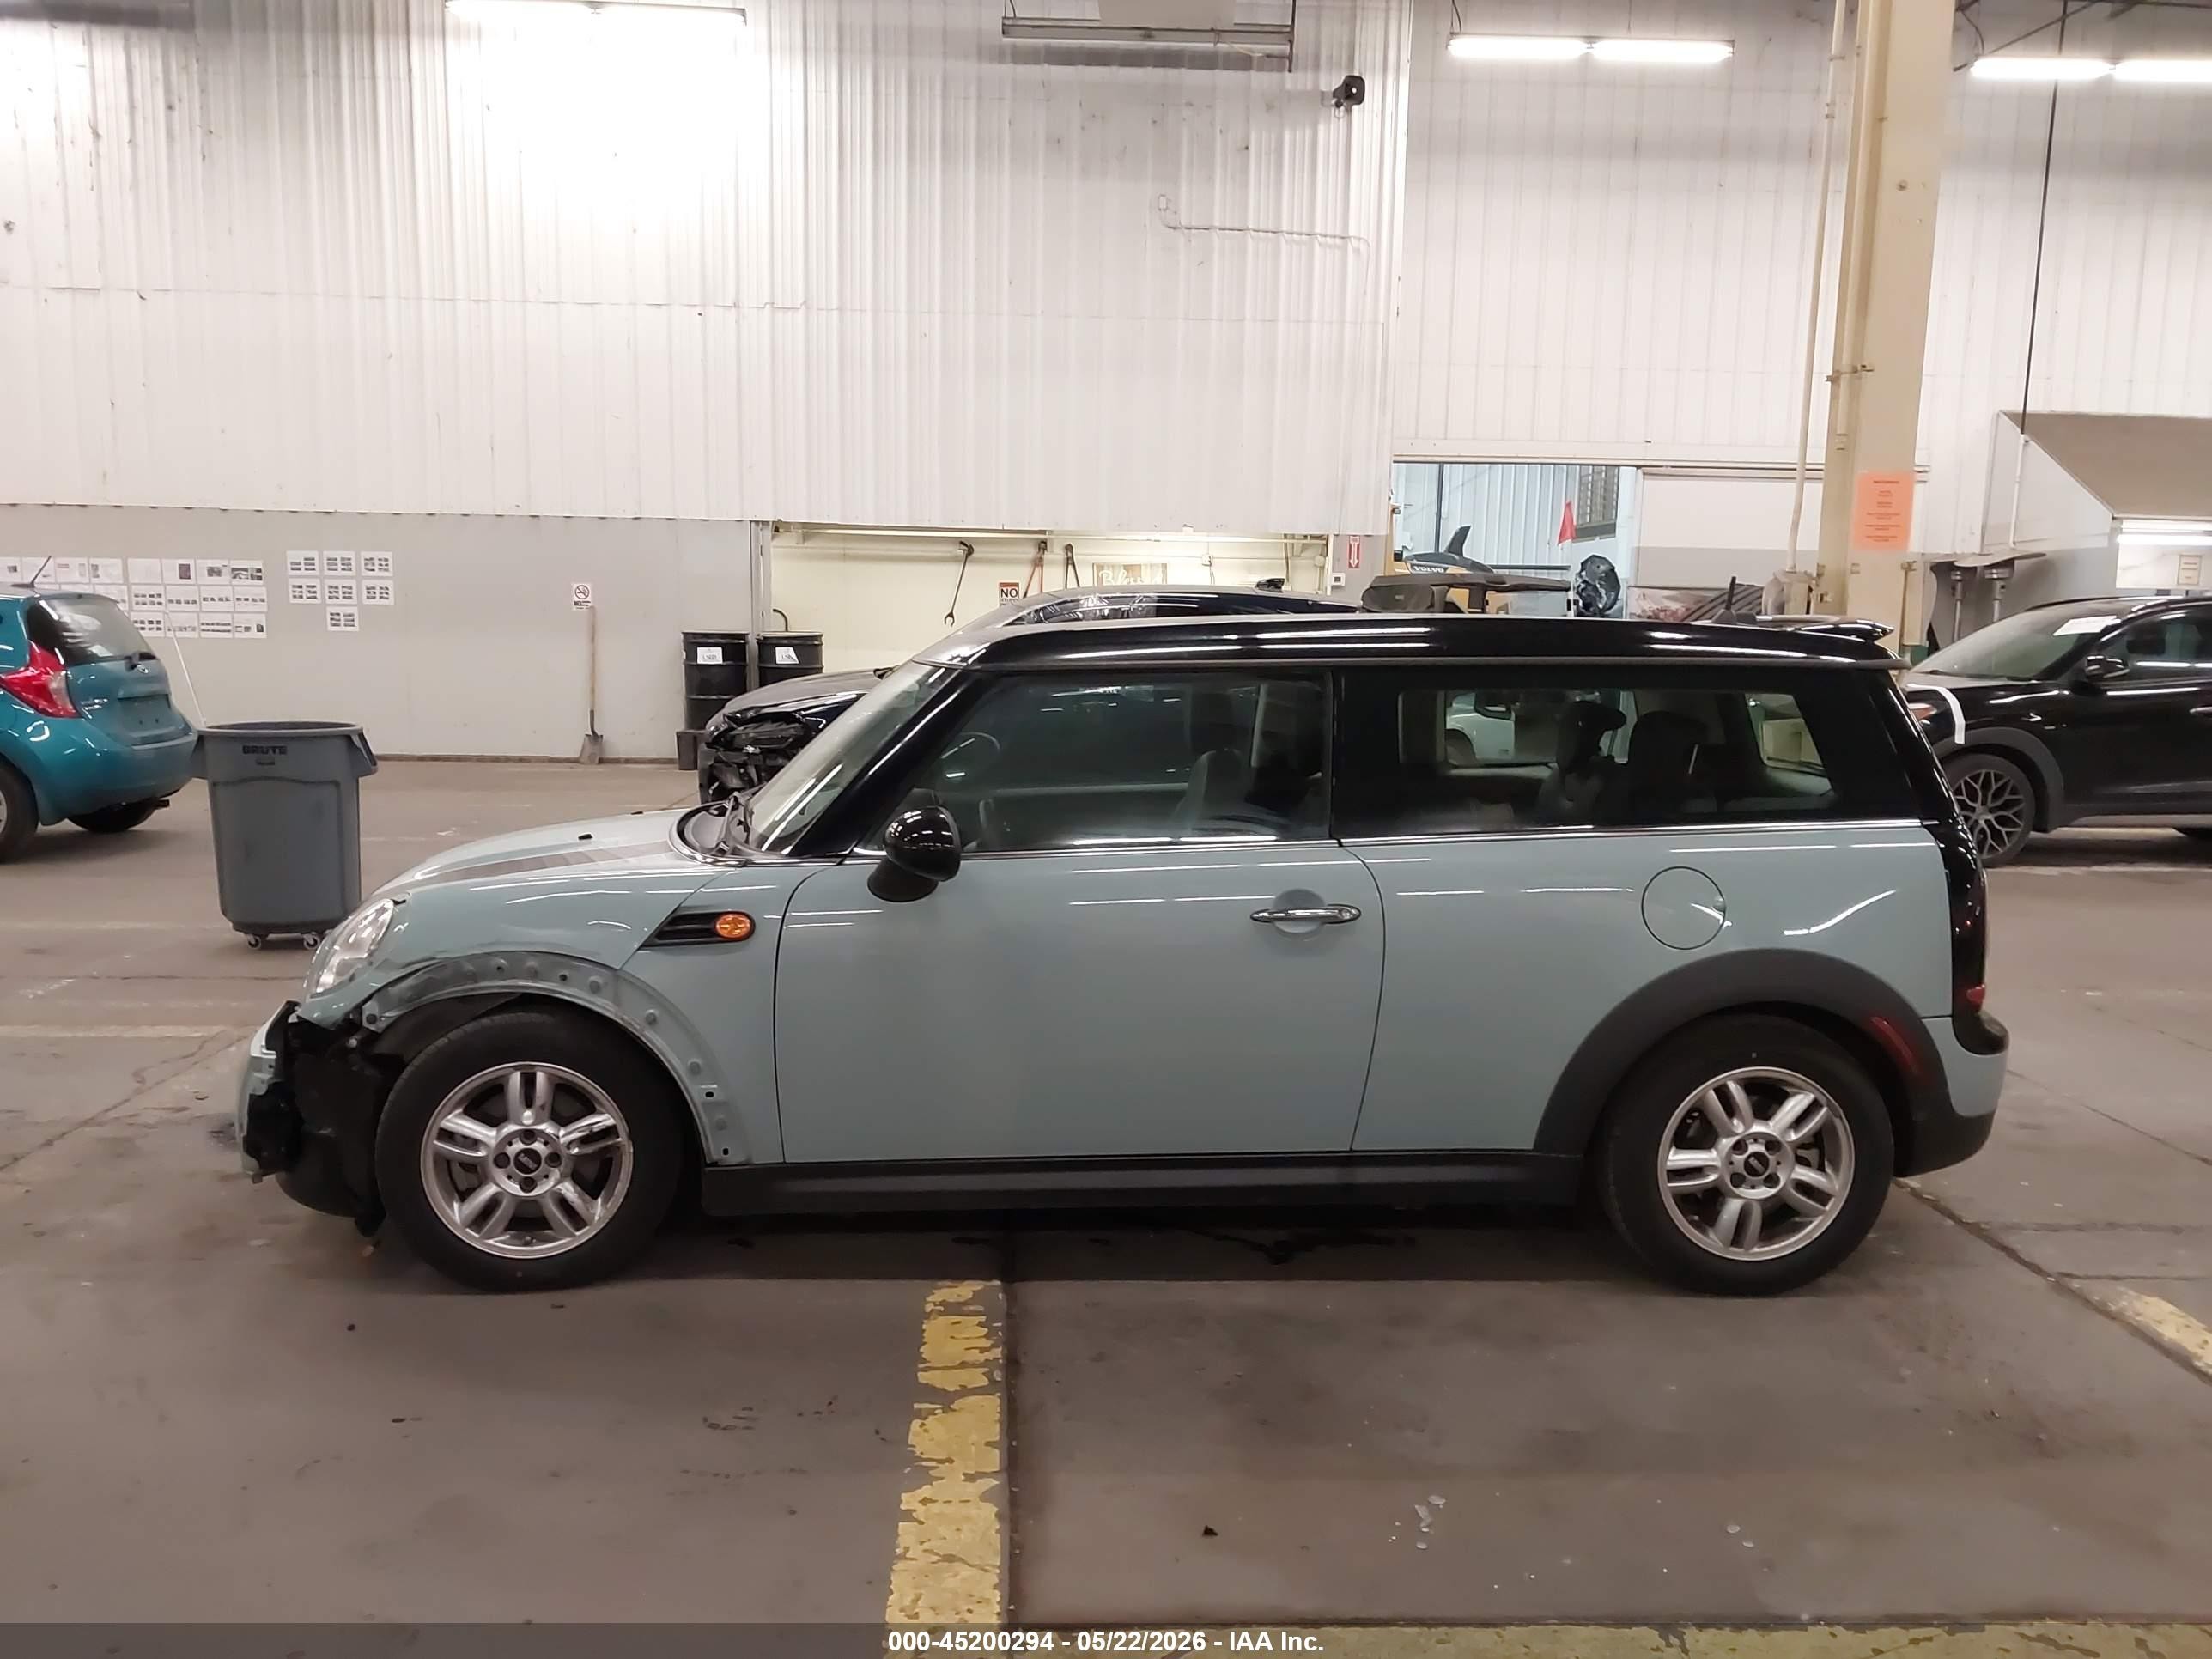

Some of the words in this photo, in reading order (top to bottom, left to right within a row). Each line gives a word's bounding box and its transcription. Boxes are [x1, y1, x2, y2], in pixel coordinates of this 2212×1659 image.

[1413, 565, 1445, 574] VOLVO
[1000, 587, 1018, 599] NO
[242, 744, 288, 755] BRUTE
